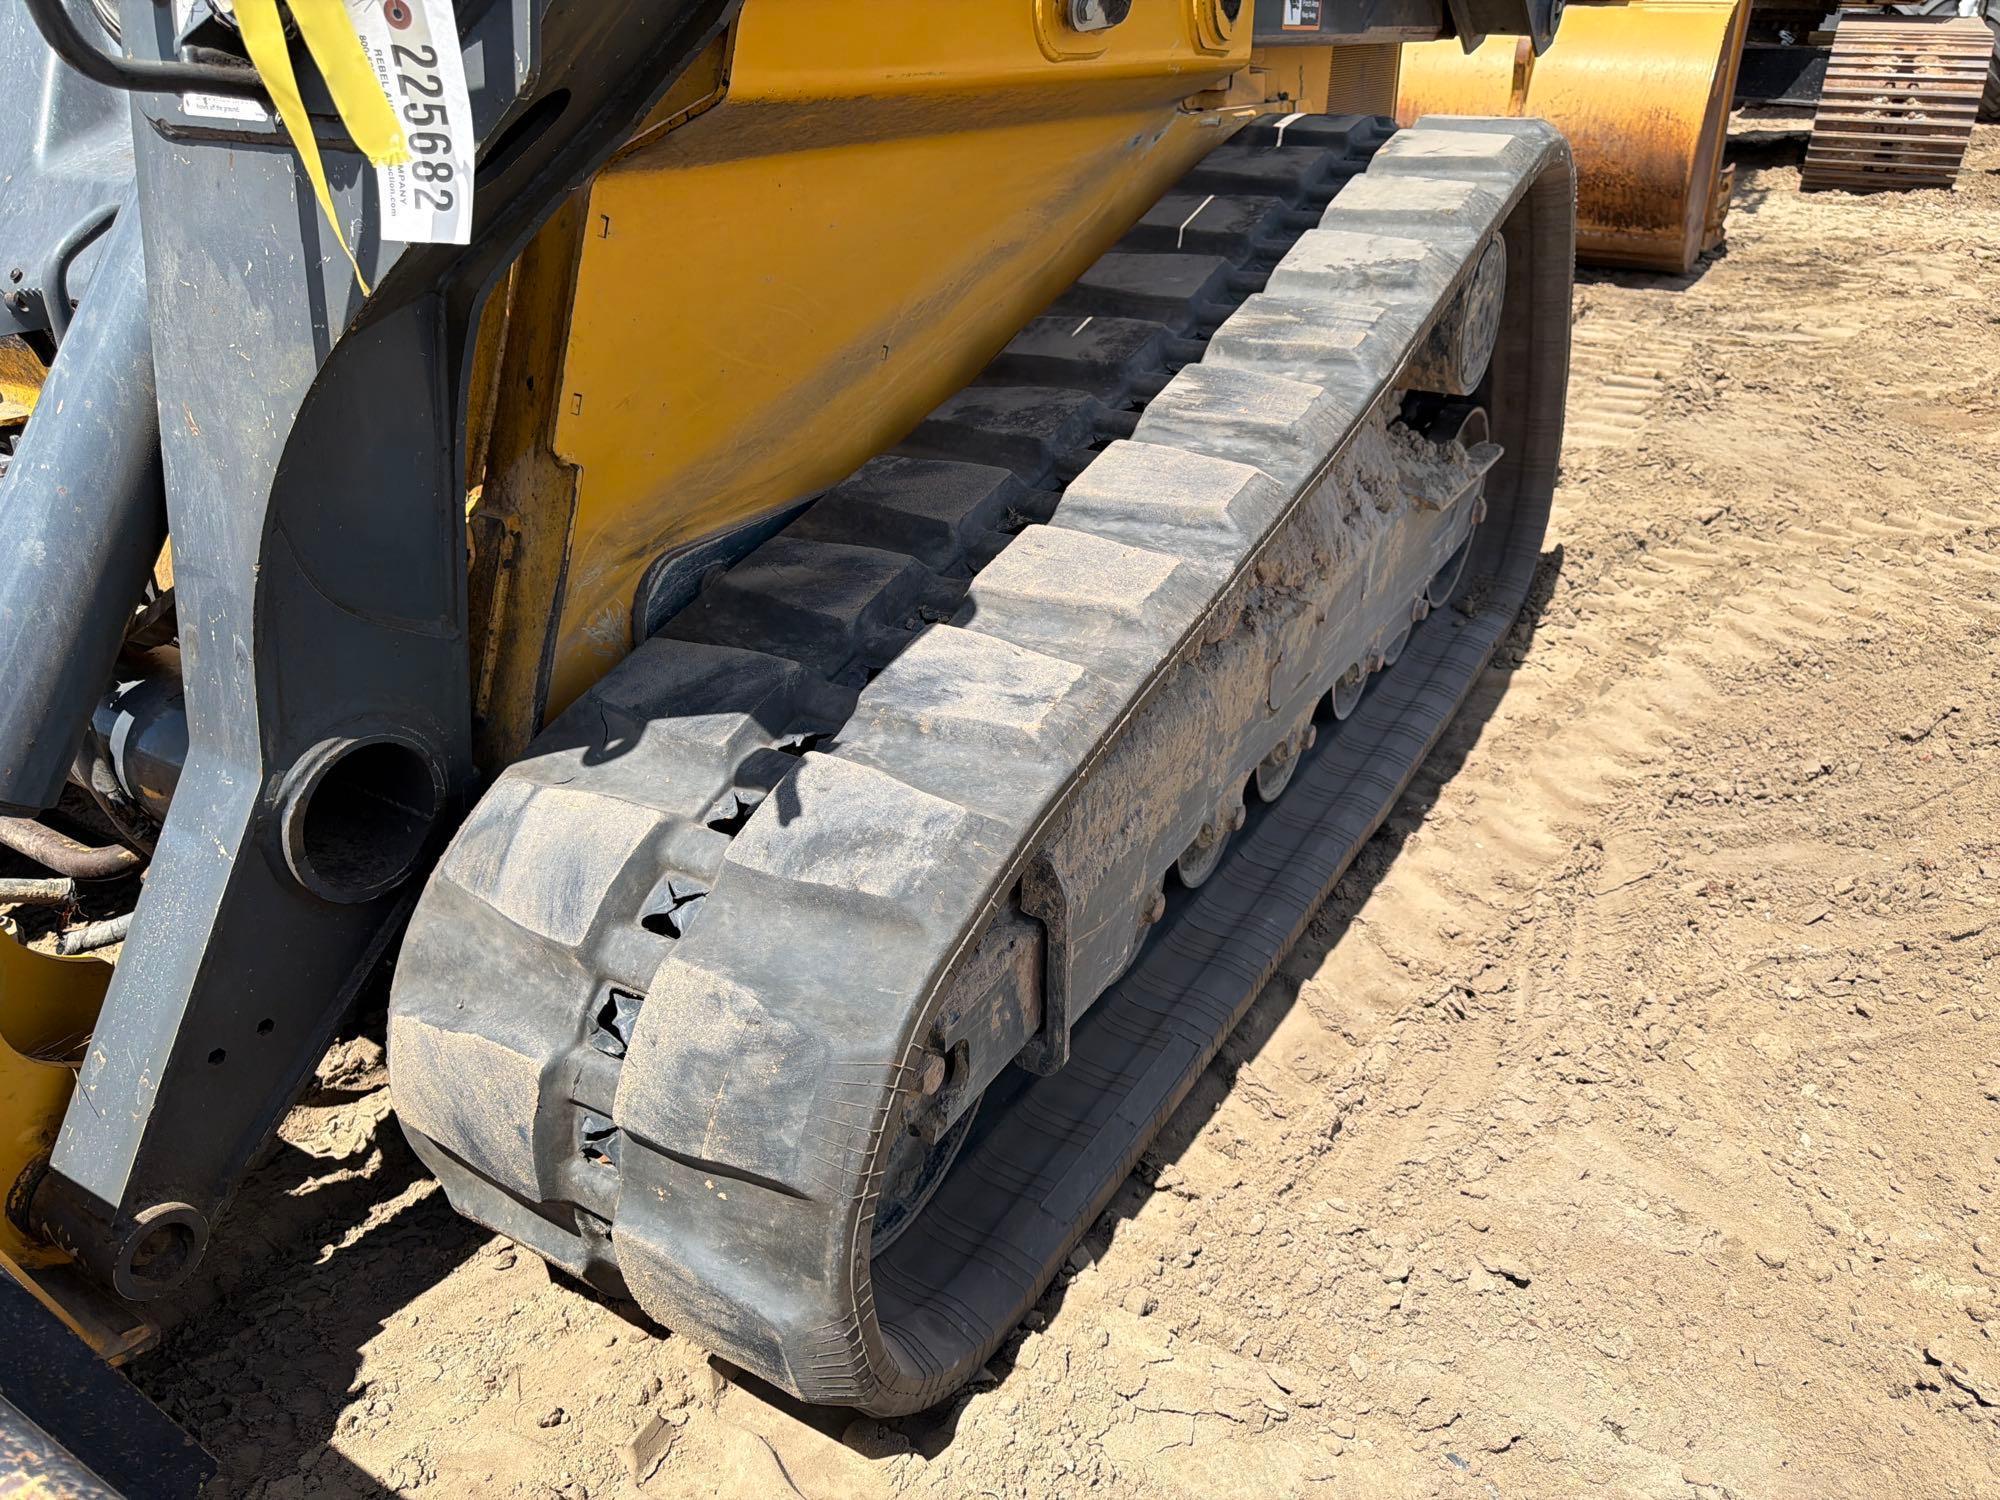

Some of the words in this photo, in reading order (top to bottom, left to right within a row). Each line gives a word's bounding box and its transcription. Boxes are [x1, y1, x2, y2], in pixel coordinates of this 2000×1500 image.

[374, 48, 389, 89] REBEL
[397, 163, 408, 206] MPANY
[390, 44, 454, 212] 225682
